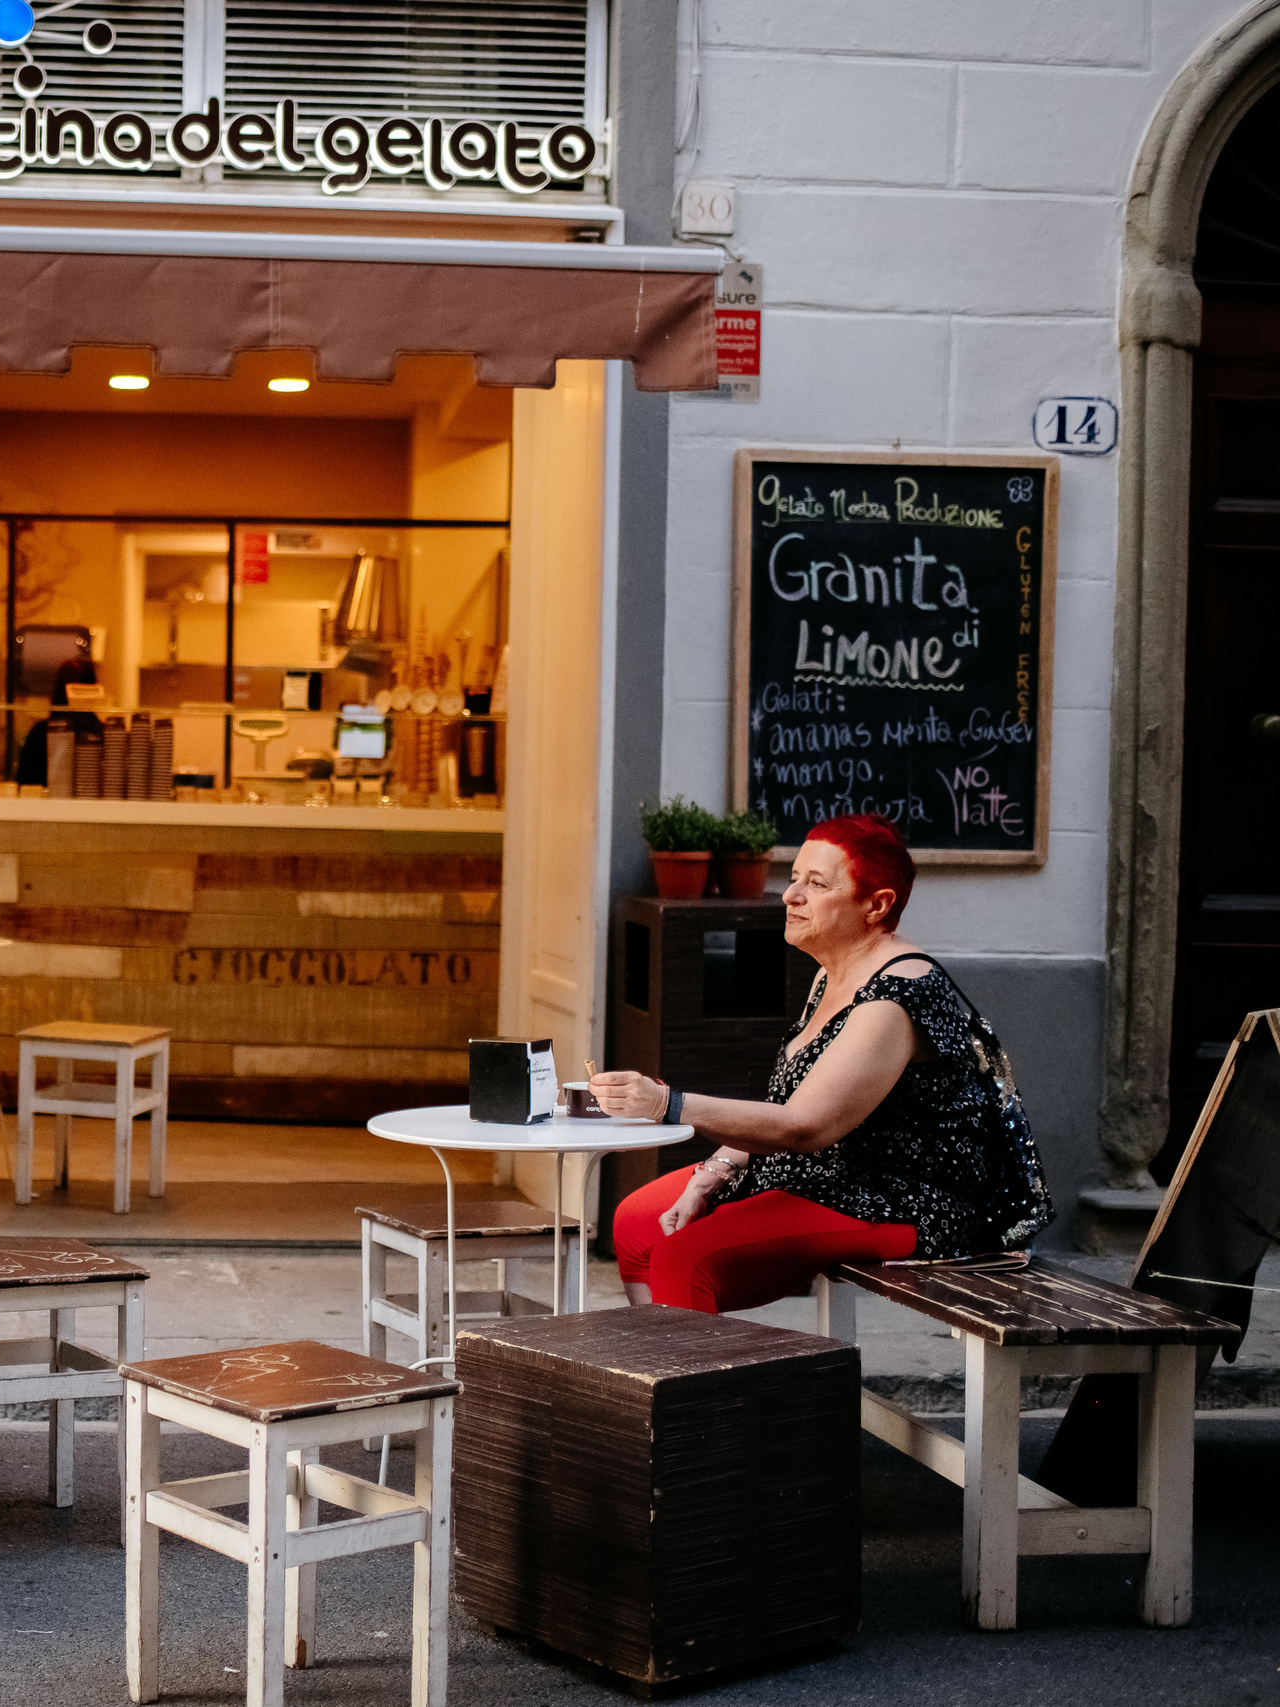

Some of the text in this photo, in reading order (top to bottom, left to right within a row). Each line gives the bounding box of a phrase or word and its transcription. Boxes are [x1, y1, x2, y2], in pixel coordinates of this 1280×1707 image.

[687, 193, 732, 222] 30
[1044, 405, 1101, 445] 14
[769, 531, 980, 614] Granita
[952, 618, 980, 649] di
[768, 722, 872, 756] ananas
[952, 765, 991, 791] NO
[171, 948, 471, 988] CIOCCOLATO
